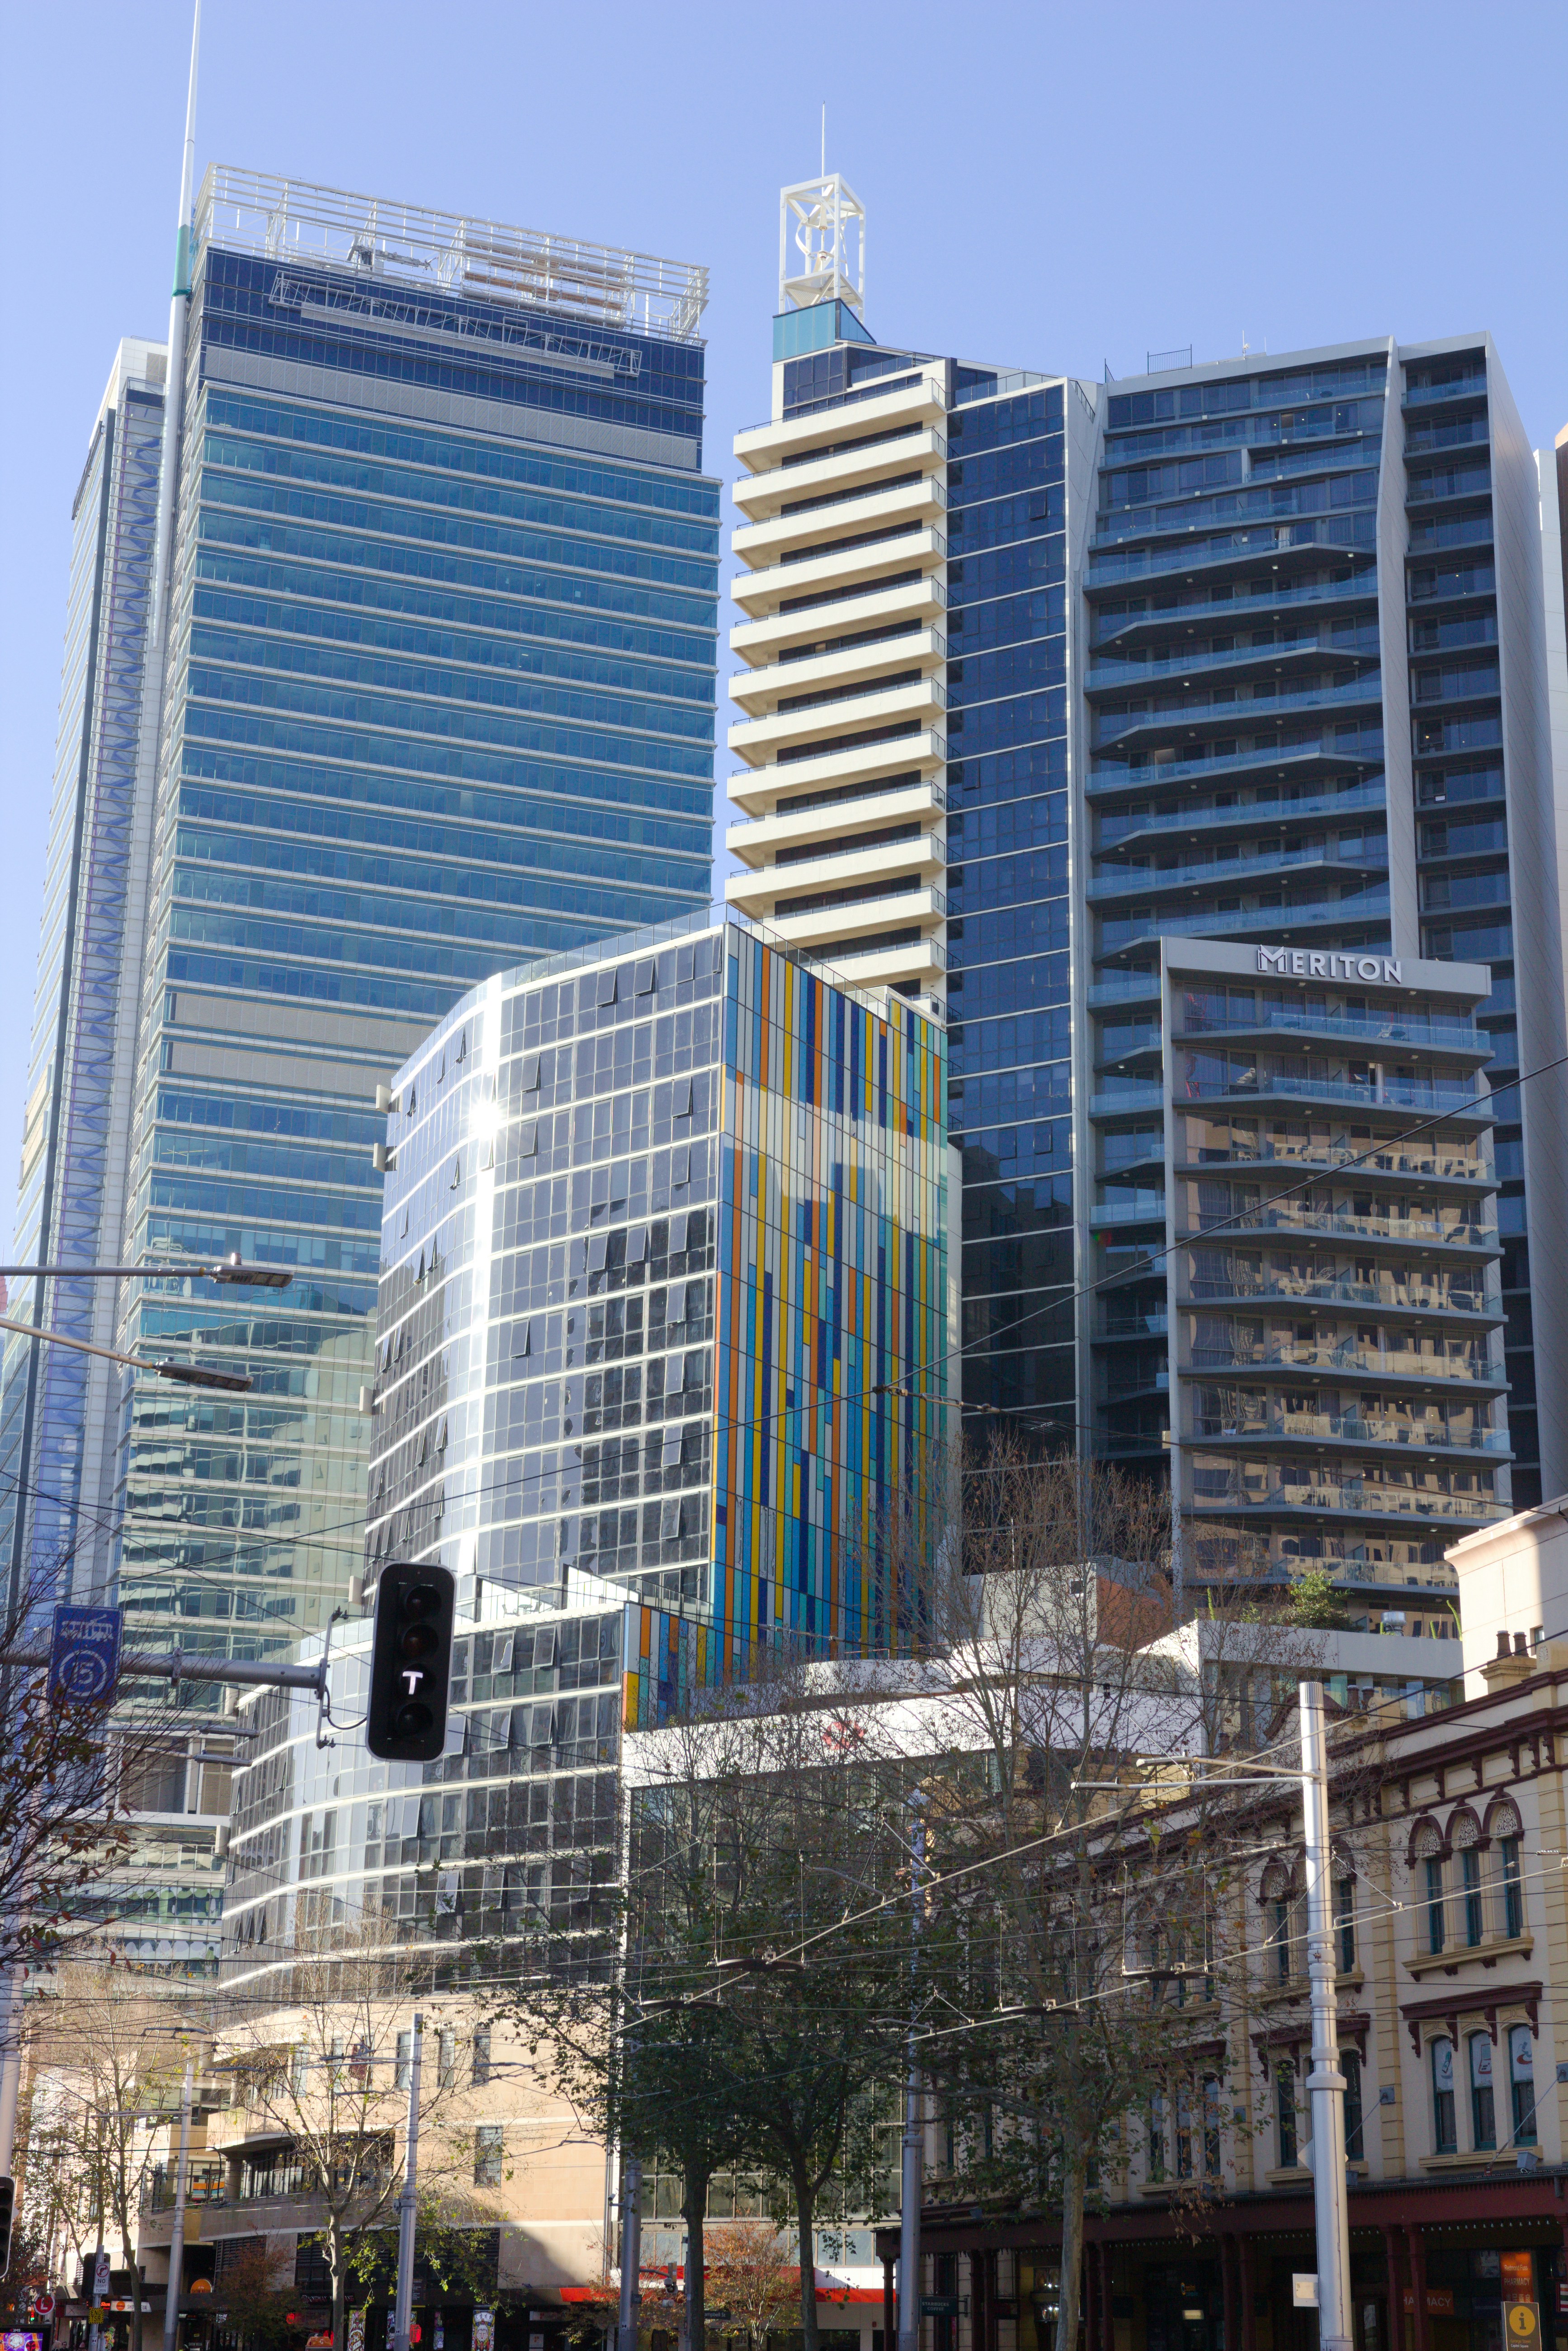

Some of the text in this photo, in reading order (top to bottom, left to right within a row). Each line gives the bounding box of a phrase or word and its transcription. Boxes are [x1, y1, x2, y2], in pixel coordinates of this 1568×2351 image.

[1257, 944, 1401, 984] MERITON
[73, 1662, 94, 1685] 15
[402, 1671, 423, 1695] T
[1504, 2278, 1530, 2286] PHARMACY
